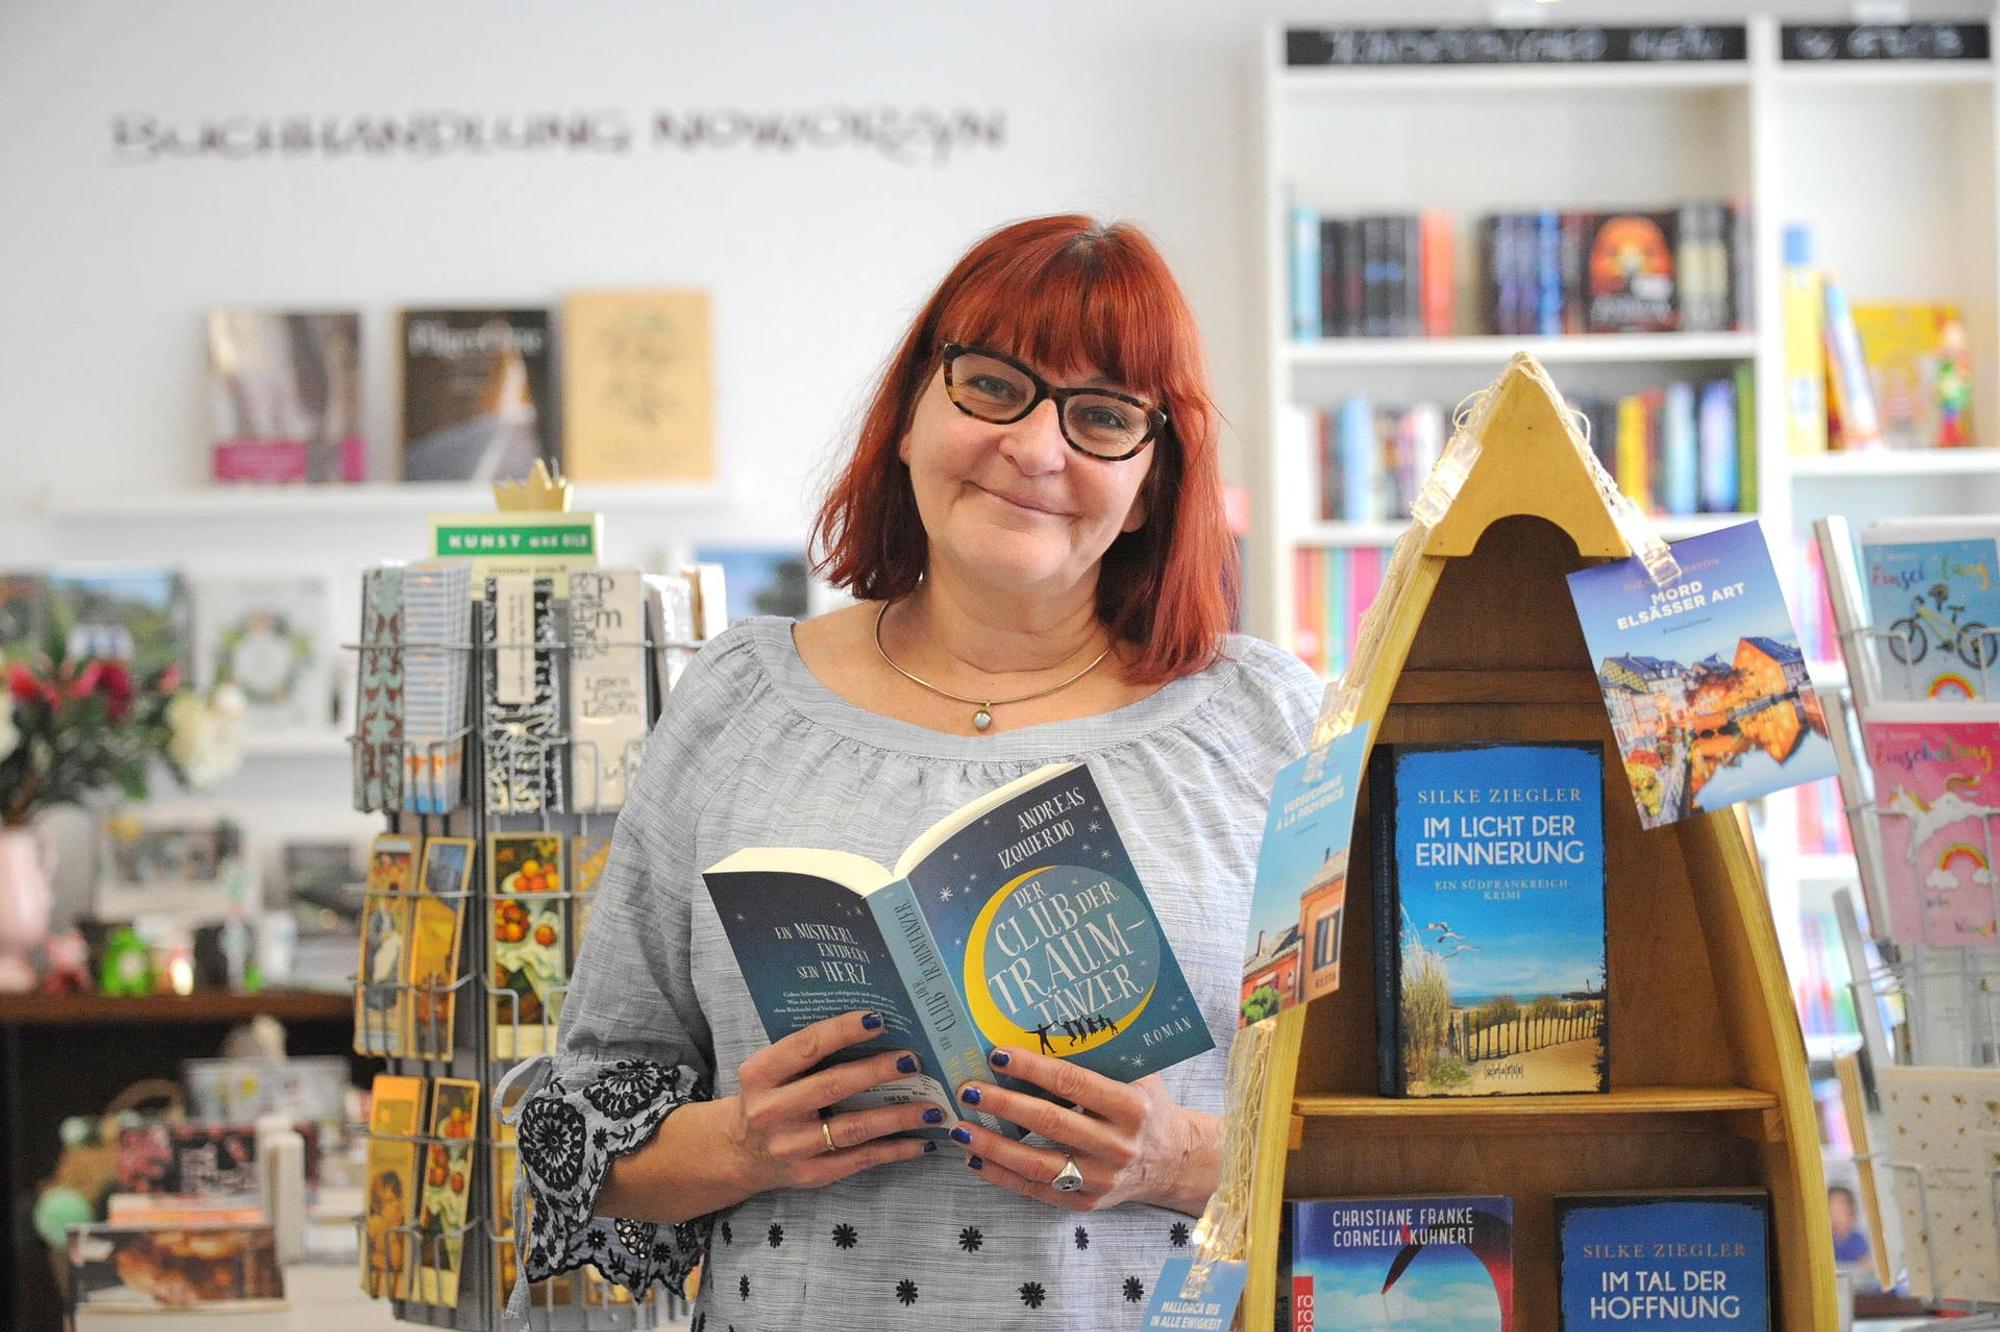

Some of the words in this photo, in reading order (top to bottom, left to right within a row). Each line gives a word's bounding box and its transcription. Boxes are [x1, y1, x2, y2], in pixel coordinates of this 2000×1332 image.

[449, 533, 521, 549] KUNST
[1651, 581, 1703, 605] MORD
[1616, 594, 1706, 631] ELSÄSSER
[1711, 582, 1746, 603] ART
[1418, 789, 1481, 804] SILKE
[1489, 788, 1582, 803] ZIEGLER
[1017, 786, 1086, 833] ANDREAS
[1424, 817, 1450, 839] IM
[1461, 816, 1525, 838] LICHT
[1532, 815, 1576, 837] DER
[998, 819, 1075, 870] IZQUIERDO
[1416, 841, 1585, 867] ERINNERUNG
[1012, 880, 1047, 910] DER
[1435, 880, 1457, 891] EIN
[1484, 891, 1521, 901] KRIMI
[995, 893, 1078, 957] CLUB
[1075, 880, 1120, 914] DER
[774, 926, 793, 939] EIN
[794, 922, 858, 945] MISTKERL
[817, 943, 870, 964] ENTDECKT
[797, 965, 820, 979] SEIN
[821, 961, 872, 986] HERZ
[1034, 963, 1144, 1032] TÄNZER
[925, 991, 957, 1032] CLUB
[1143, 1016, 1193, 1047] ROMAN
[1332, 1208, 1413, 1227] CHRISTIANE
[1420, 1207, 1473, 1224] FRANKE
[1333, 1230, 1403, 1248] CORNELIA
[1410, 1227, 1475, 1246] KUHNERT
[1583, 1244, 1645, 1259] SILKE
[1653, 1243, 1746, 1258] ZIEGLER
[1602, 1271, 1629, 1292] IM
[1635, 1270, 1676, 1292] TAL
[1683, 1270, 1726, 1291] DER
[1160, 1300, 1205, 1315] MALLORCA
[1297, 1295, 1313, 1308] ro
[1590, 1295, 1741, 1320] HOFFNUNG
[1160, 1316, 1181, 1329] ALLE
[1297, 1310, 1313, 1323] ro
